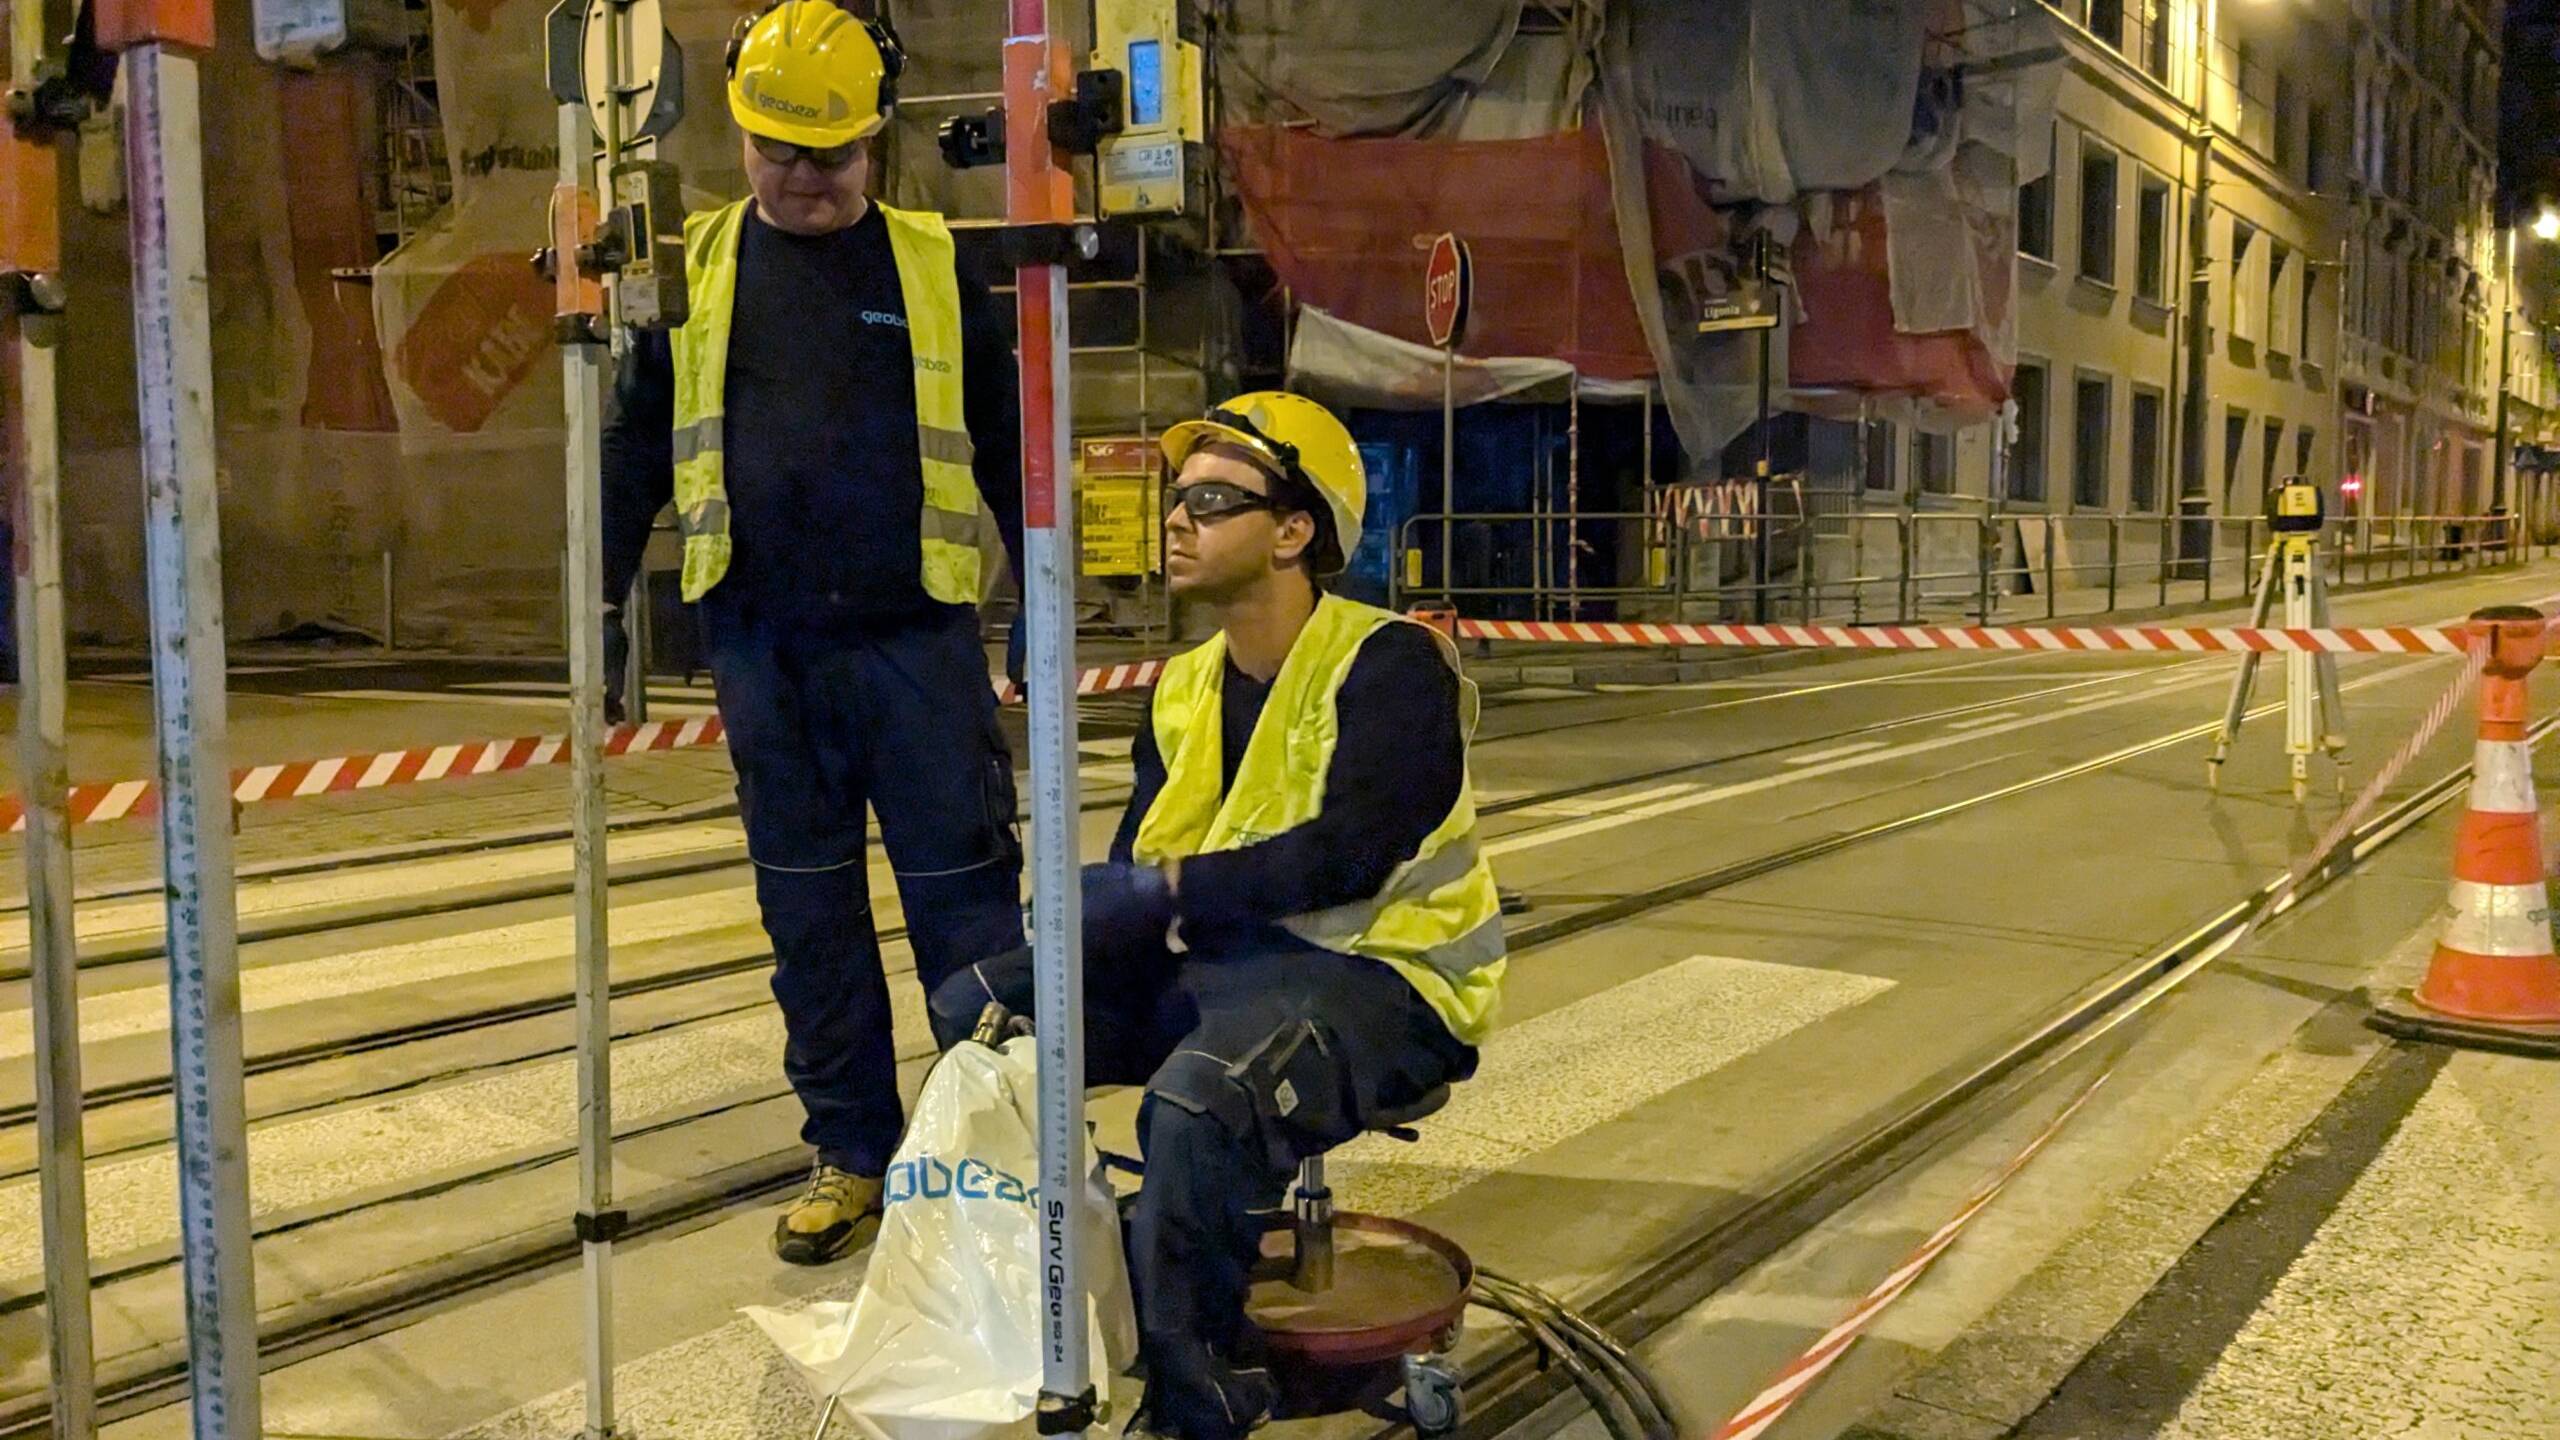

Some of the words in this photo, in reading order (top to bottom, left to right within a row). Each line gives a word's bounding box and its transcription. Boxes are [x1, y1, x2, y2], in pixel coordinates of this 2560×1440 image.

[758, 93, 822, 118] geobear
[1430, 270, 1455, 309] STOP
[883, 1151, 1040, 1209] obear
